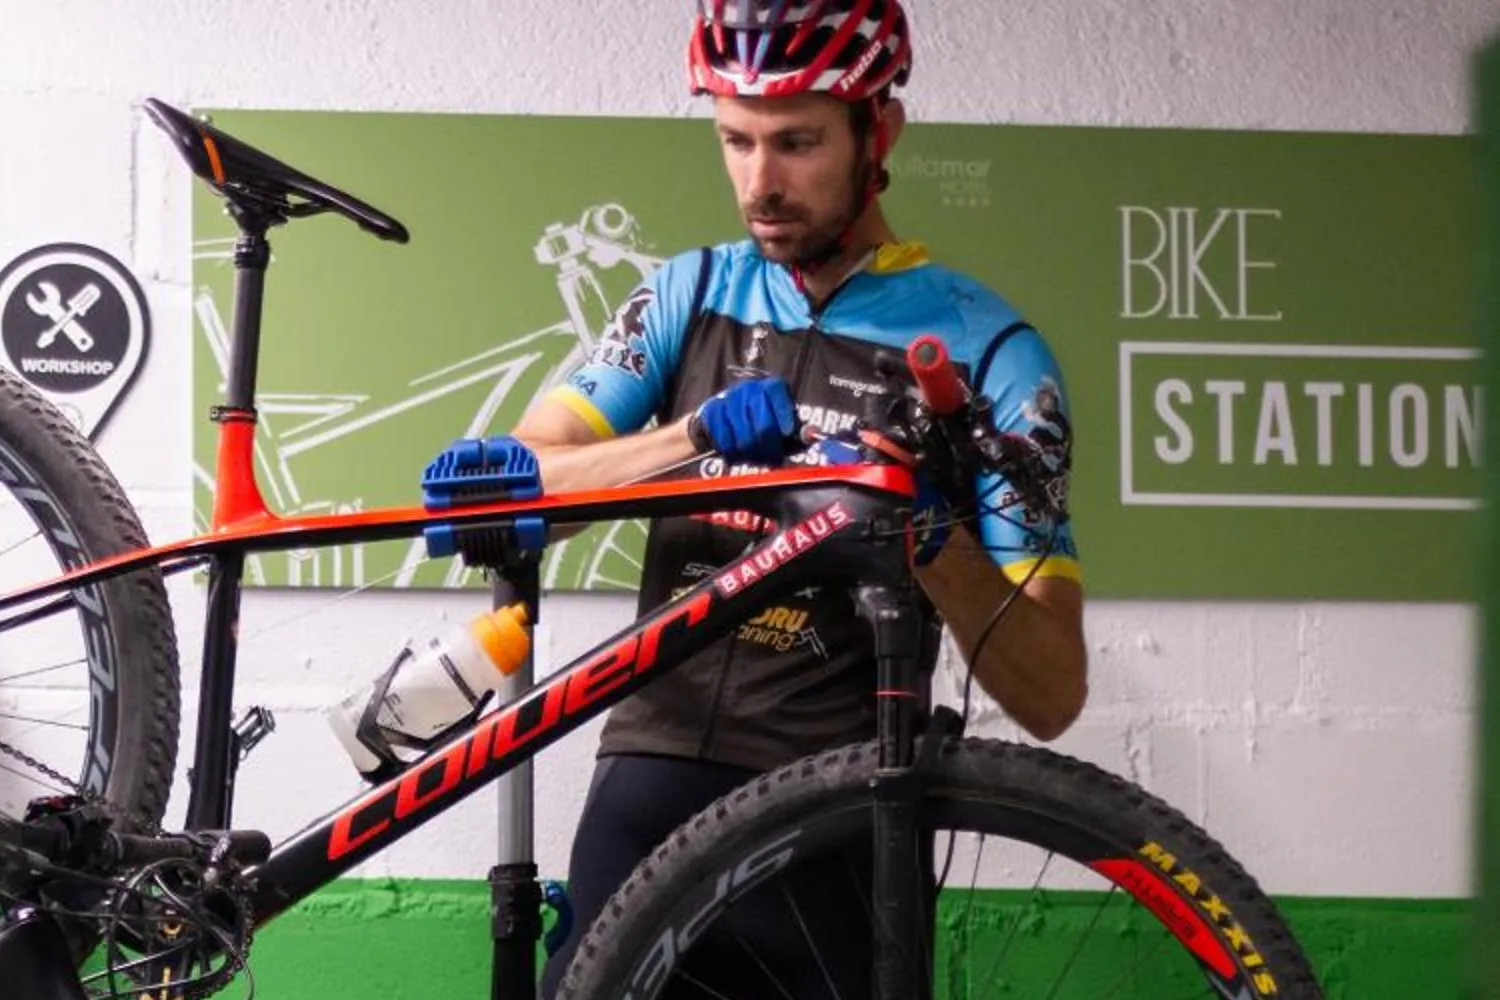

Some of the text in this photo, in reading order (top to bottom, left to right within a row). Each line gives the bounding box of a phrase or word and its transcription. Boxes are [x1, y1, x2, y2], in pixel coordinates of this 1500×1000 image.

[1118, 205, 1282, 321] BIKE
[21, 356, 114, 377] WORKSHOP
[1153, 377, 1483, 468] STATION
[719, 501, 848, 592] BAUHAUS
[1139, 839, 1278, 995] MAXXIS
